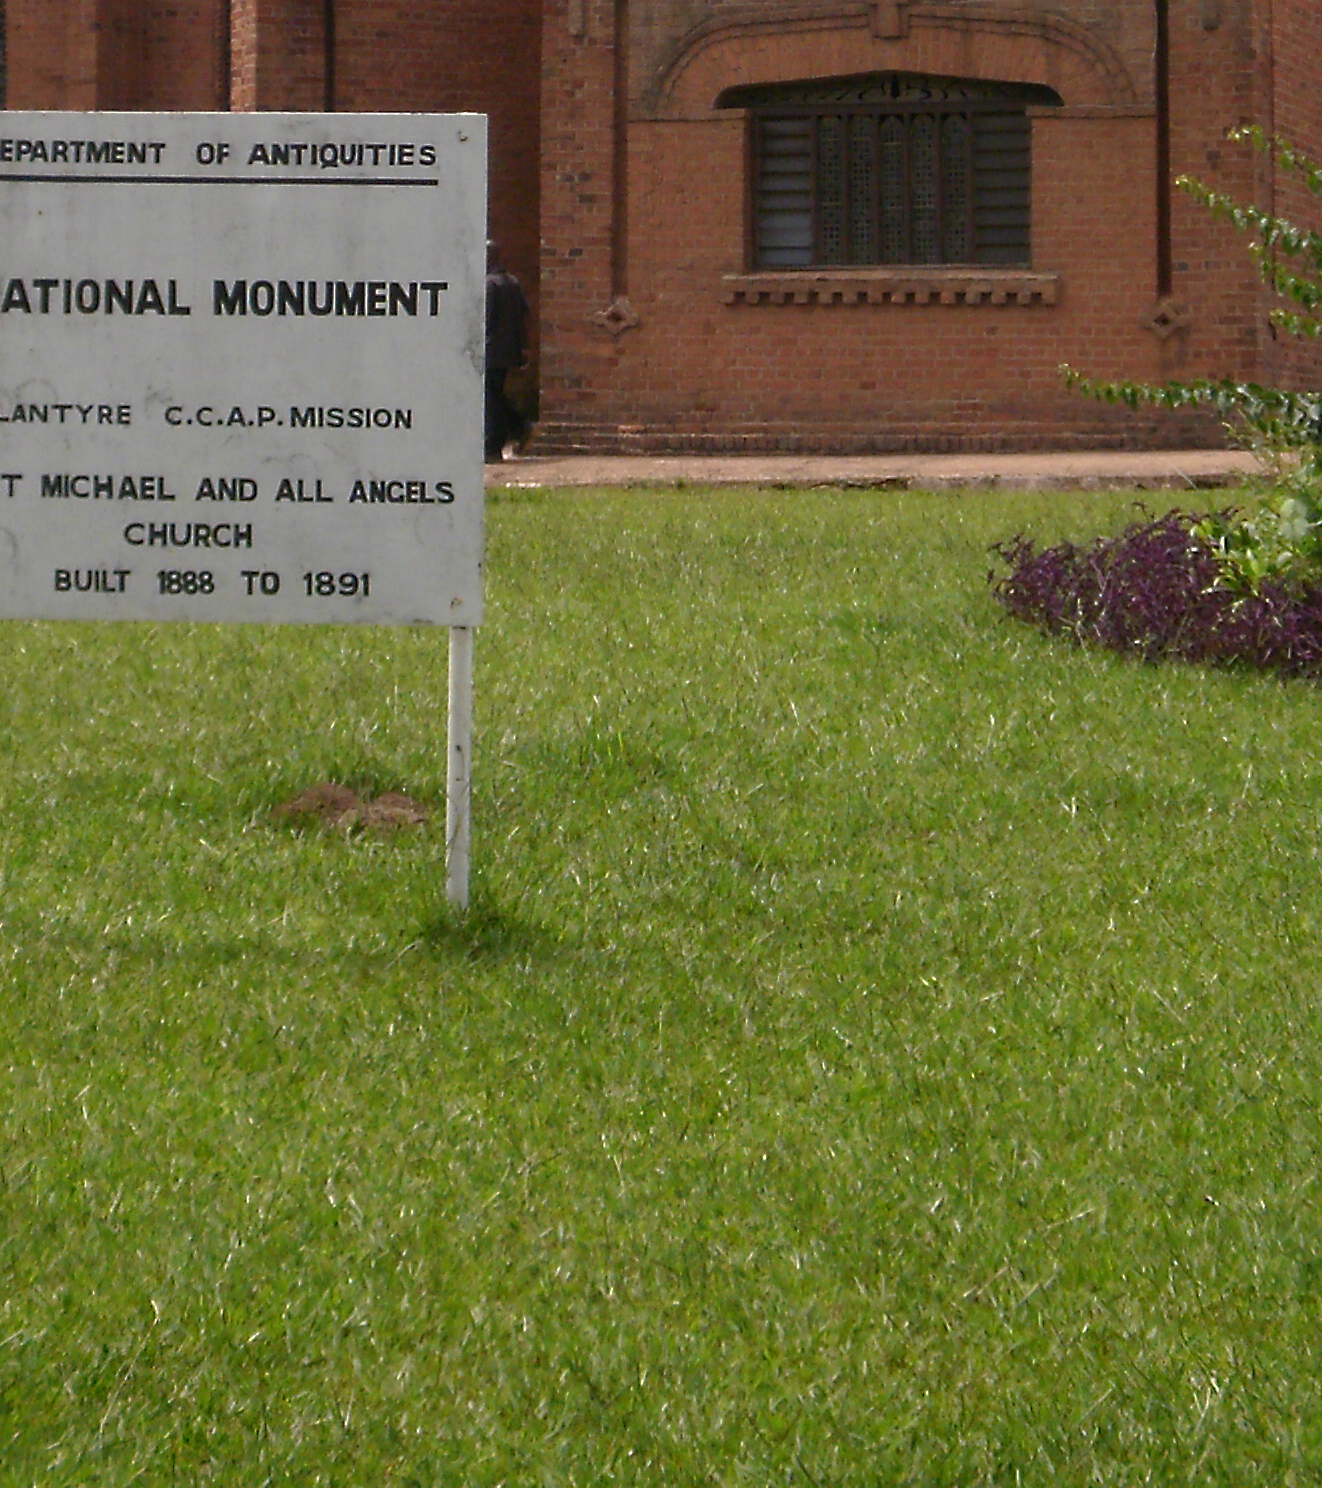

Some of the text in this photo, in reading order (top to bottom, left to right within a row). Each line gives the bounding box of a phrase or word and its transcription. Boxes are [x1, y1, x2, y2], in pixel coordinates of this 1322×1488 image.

[195, 141, 232, 167] OF
[247, 139, 438, 170] ANTIQUITIES
[213, 279, 449, 318] MONUMENT
[40, 473, 176, 502] MICHAEL
[194, 476, 258, 503] AND
[274, 477, 334, 504] ALL
[348, 479, 456, 506] ANGELS
[123, 521, 253, 550] CHURCH
[54, 568, 372, 598] BUILT 1888 TO 1891
